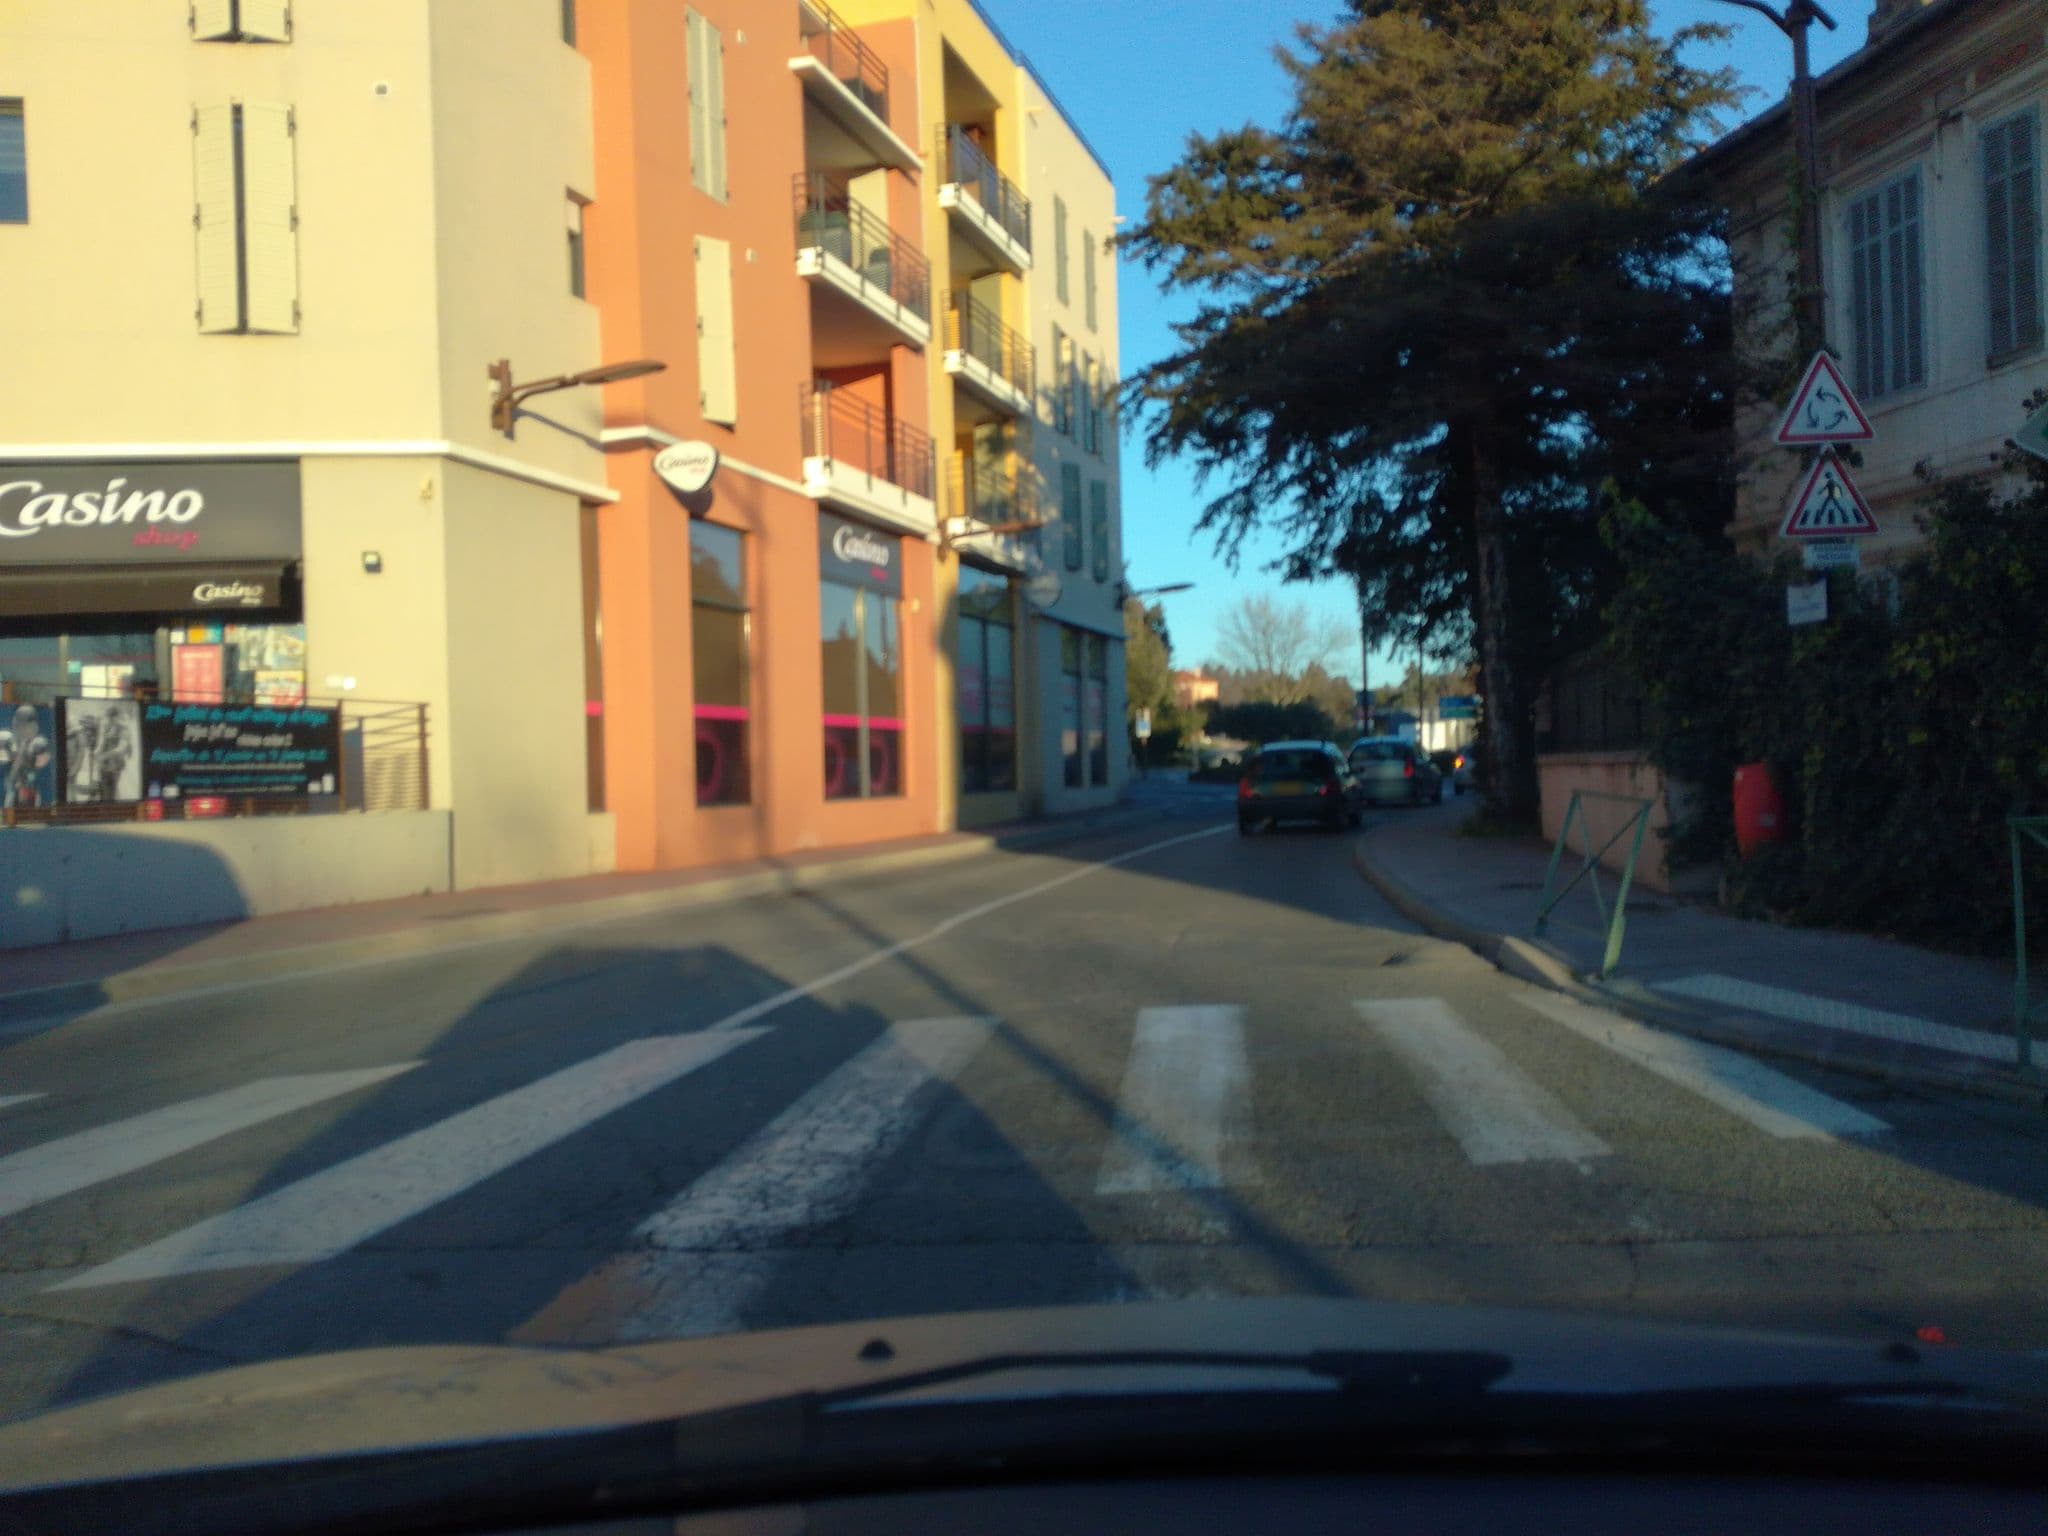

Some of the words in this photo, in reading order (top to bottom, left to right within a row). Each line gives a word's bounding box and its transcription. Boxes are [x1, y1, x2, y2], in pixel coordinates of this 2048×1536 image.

[0, 478, 204, 536] Casino
[833, 526, 889, 567] Casino
[193, 582, 264, 602] Casino
